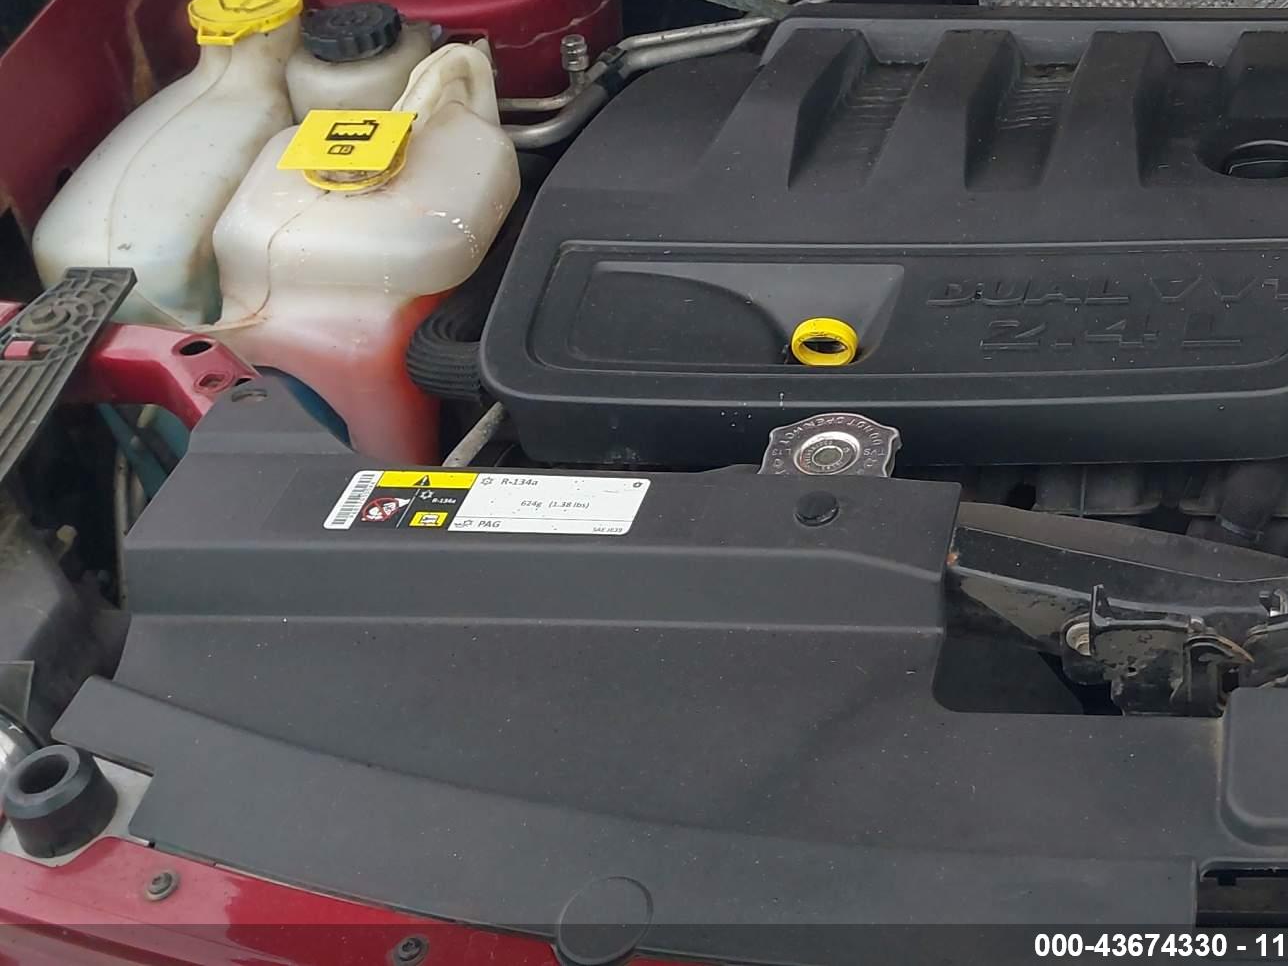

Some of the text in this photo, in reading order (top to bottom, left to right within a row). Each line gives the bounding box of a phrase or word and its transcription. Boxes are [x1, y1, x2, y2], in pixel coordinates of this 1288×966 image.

[927, 278, 1129, 306] DUAL
[500, 478, 539, 486] R-134a
[520, 500, 590, 509] 624g (1.38 lbs)
[477, 519, 501, 528] PAG
